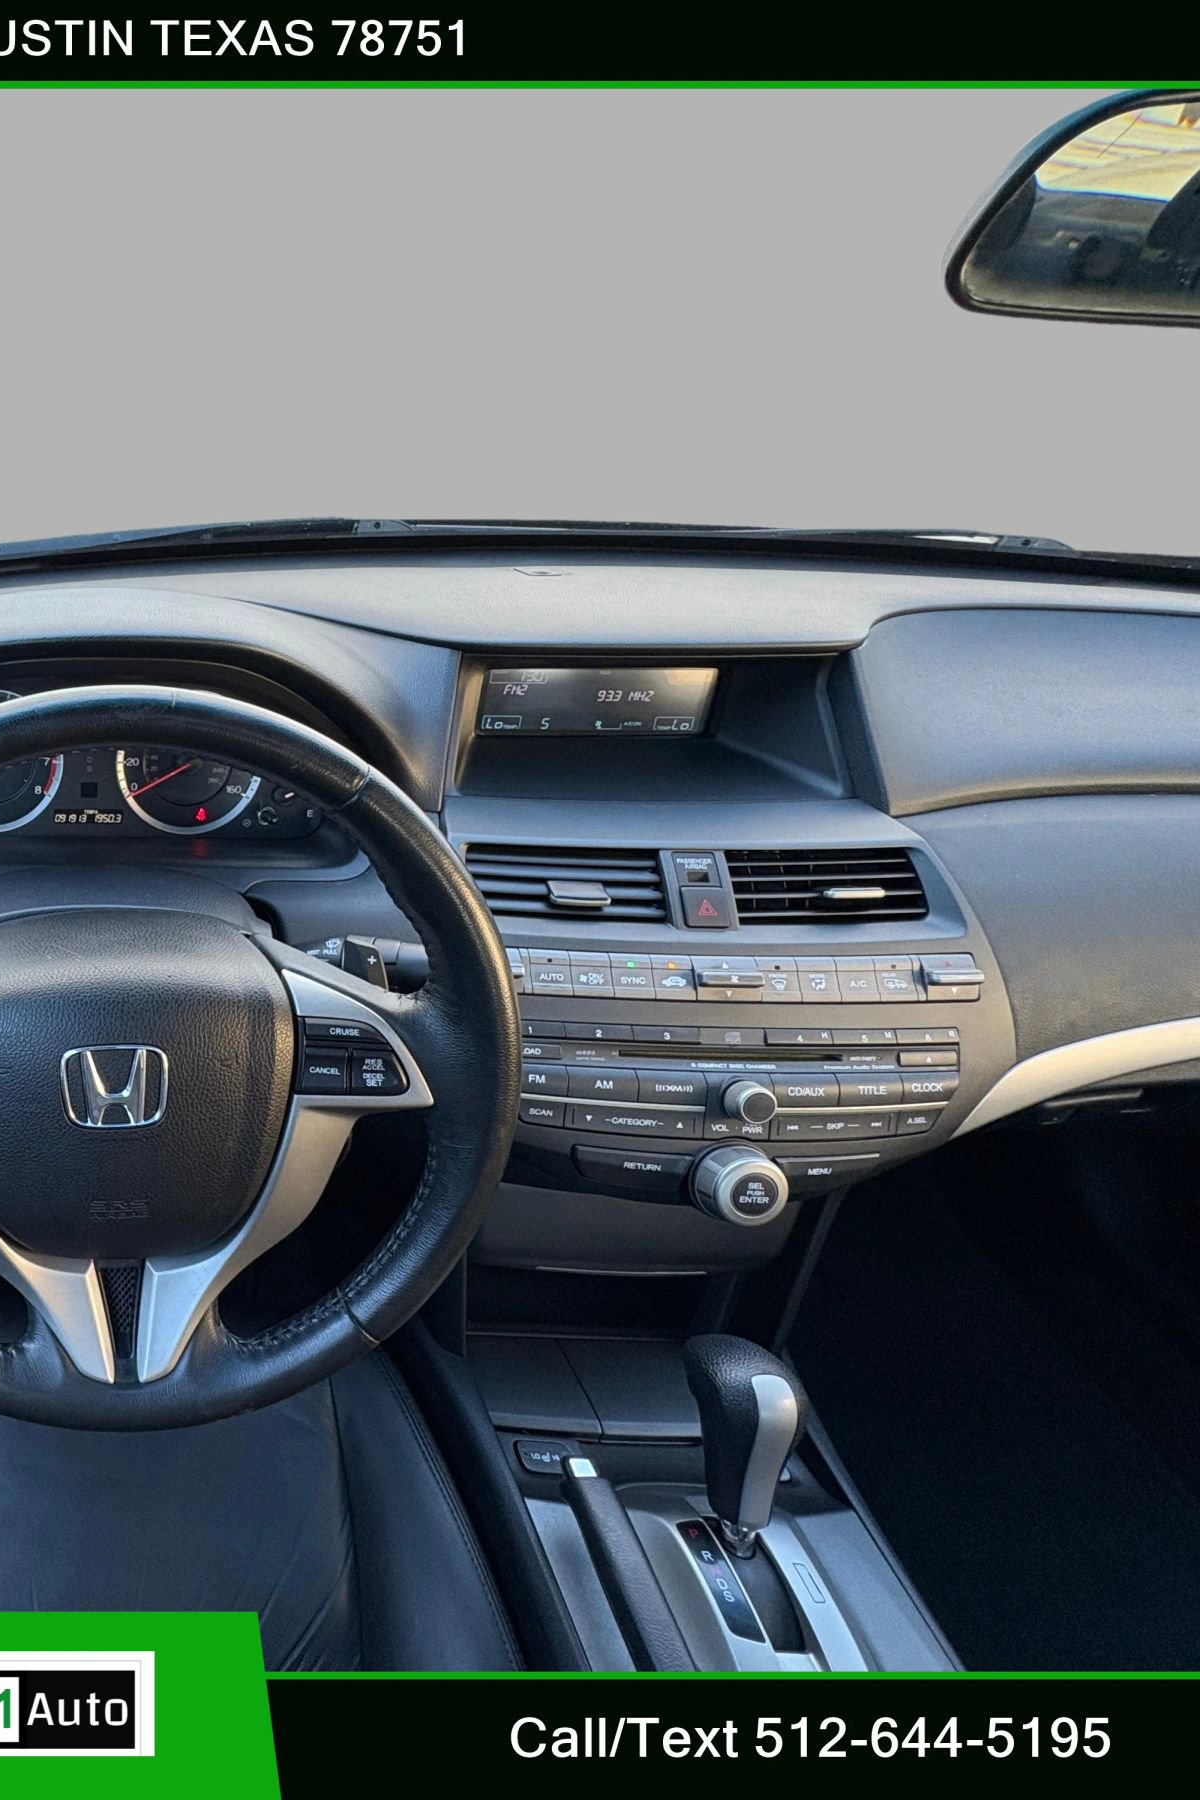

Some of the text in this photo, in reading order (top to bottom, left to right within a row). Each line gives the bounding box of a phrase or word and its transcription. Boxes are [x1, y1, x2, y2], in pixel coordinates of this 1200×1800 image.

[503, 684, 528, 695] FM2
[126, 758, 140, 767] 20
[34, 785, 42, 795] 8
[130, 782, 138, 791] 0
[226, 785, 242, 794] 160
[306, 809, 314, 818] E
[539, 973, 564, 982] AUTO
[620, 976, 647, 985] SYNC
[850, 980, 868, 988] A/C
[329, 1027, 360, 1036] CRUISE
[595, 1029, 603, 1038] 2
[664, 1032, 671, 1041] 3
[797, 1034, 803, 1042] 4
[861, 1034, 868, 1043] 5
[309, 1066, 341, 1075] CANCEL
[365, 1079, 383, 1087] SET
[528, 1075, 546, 1083] FM
[595, 1080, 614, 1090] AM
[911, 1083, 943, 1092] CLOCK
[787, 1087, 825, 1097] CD/AUX
[857, 1085, 888, 1095] TITLE
[529, 1108, 553, 1117] SCAN
[611, 1117, 657, 1127] CATEGORY
[826, 1122, 845, 1131] SKIP
[711, 1124, 729, 1132] VOL
[742, 1126, 763, 1134] PWR
[623, 1162, 661, 1172] RETURN
[807, 1168, 832, 1176] MENU
[748, 1182, 765, 1190] SEL
[739, 1196, 769, 1204] ENTER
[701, 1550, 714, 1561] R
[715, 1578, 729, 1590] D
[722, 1590, 736, 1603] S
